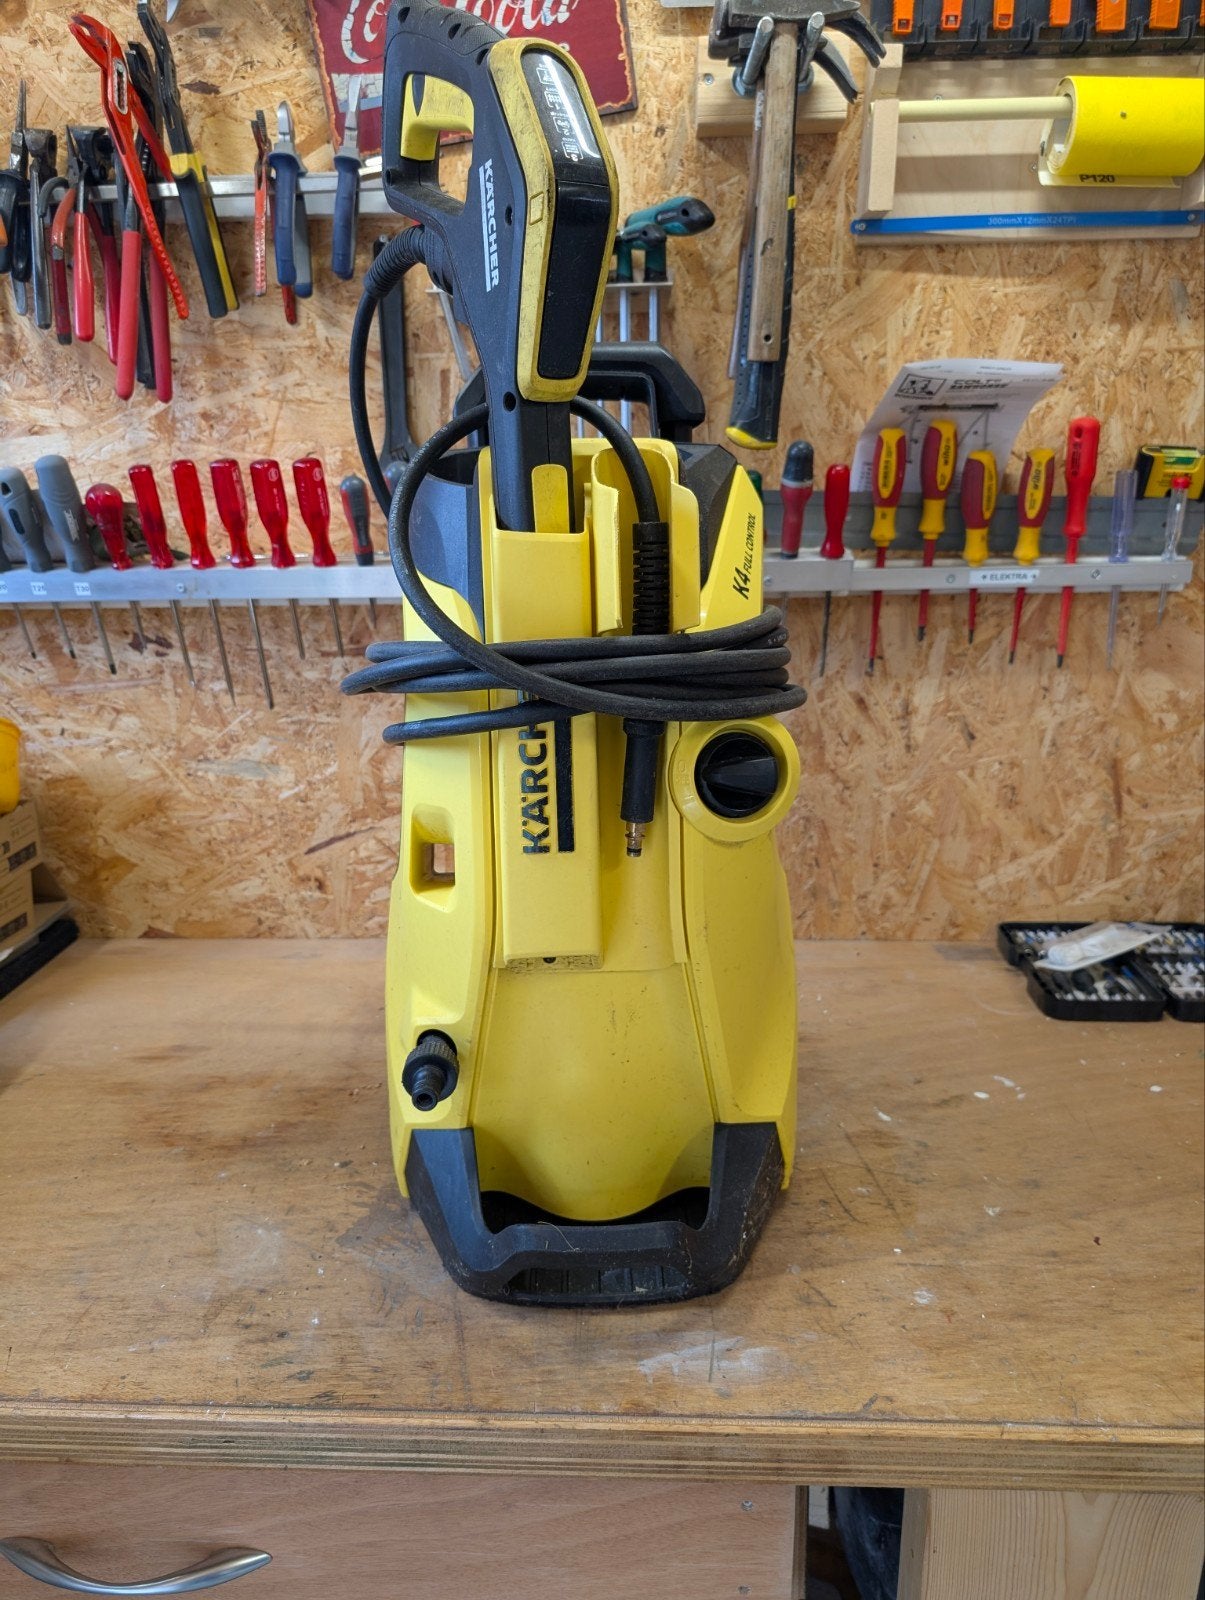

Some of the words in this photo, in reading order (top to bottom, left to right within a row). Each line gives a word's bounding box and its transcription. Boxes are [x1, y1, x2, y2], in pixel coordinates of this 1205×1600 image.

[1079, 174, 1116, 184] P120
[484, 158, 500, 288] KÄRCHER
[745, 512, 757, 553] CONTROL
[743, 552, 753, 575] FULL
[732, 566, 751, 601] K4
[518, 690, 551, 854] KÄRCH
